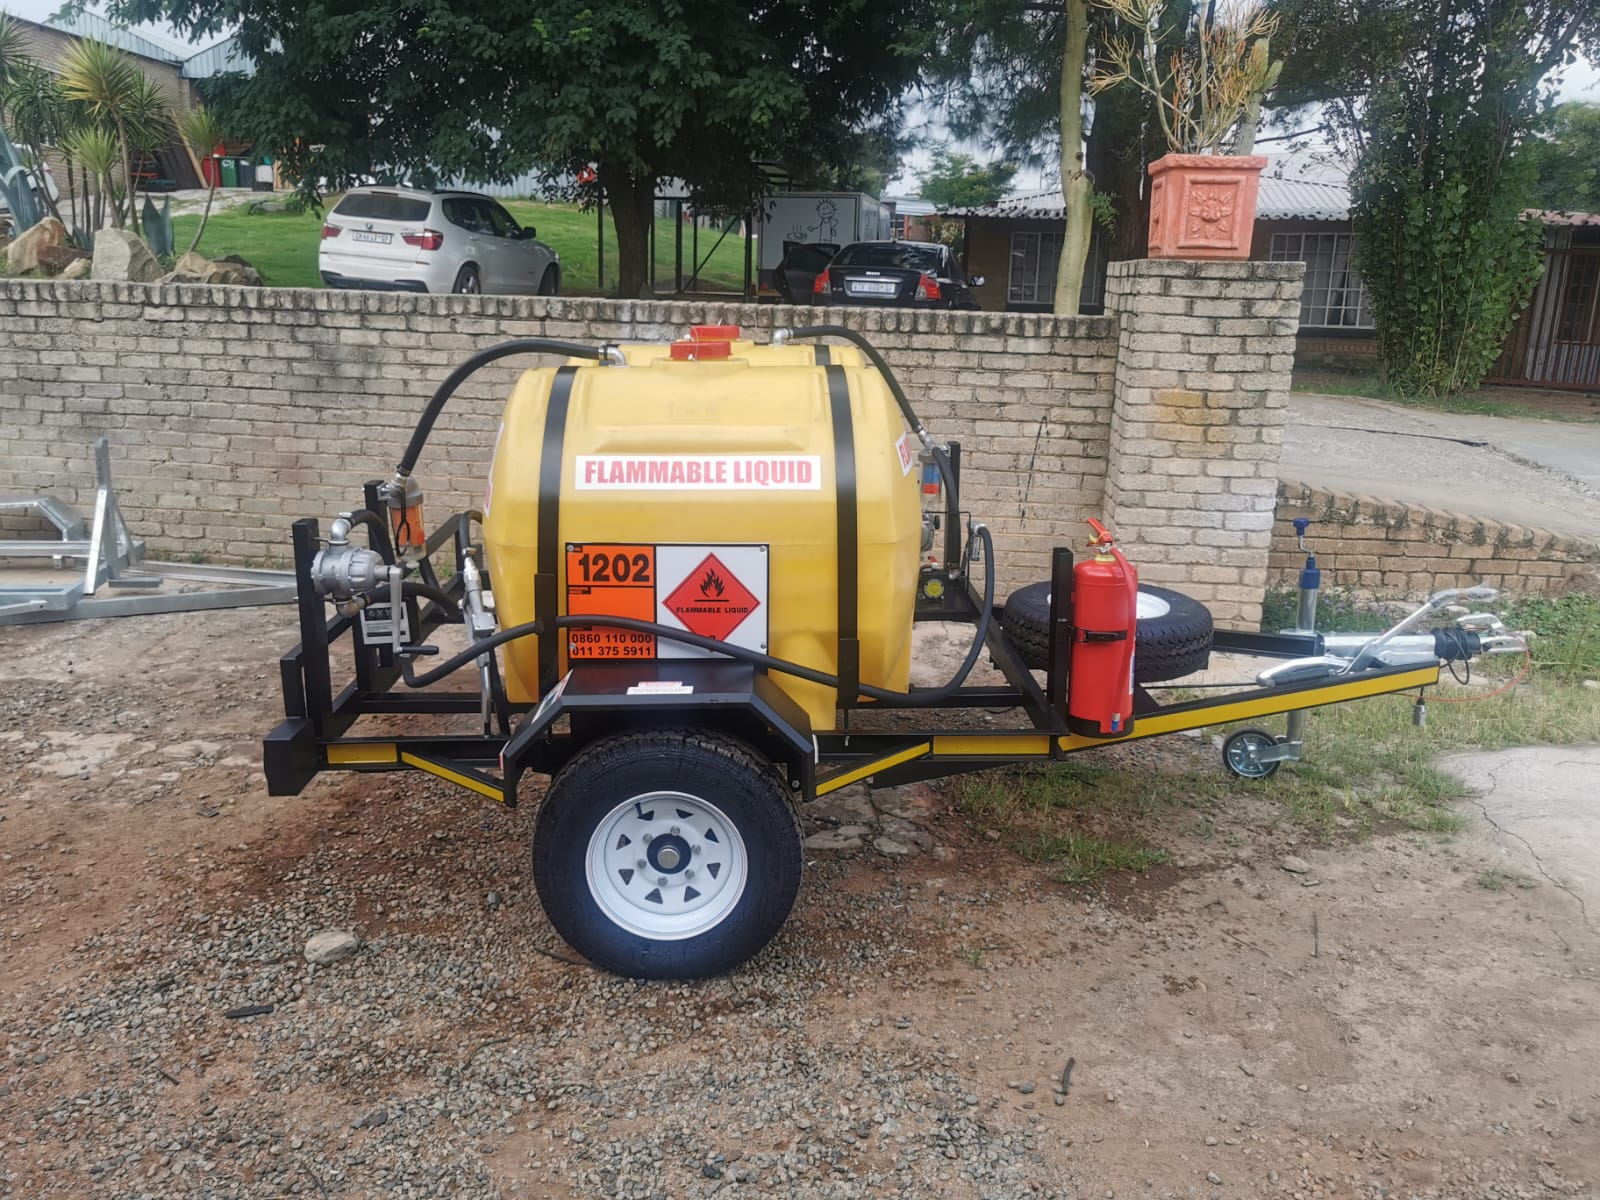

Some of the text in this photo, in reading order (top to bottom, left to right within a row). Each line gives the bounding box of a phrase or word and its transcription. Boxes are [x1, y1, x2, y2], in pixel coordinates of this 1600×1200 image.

[585, 460, 812, 486] FLAMMABLE LIQUID
[578, 553, 650, 583] 1202
[572, 633, 652, 643] 0860 110 000
[572, 646, 651, 656] 011 375 5911
